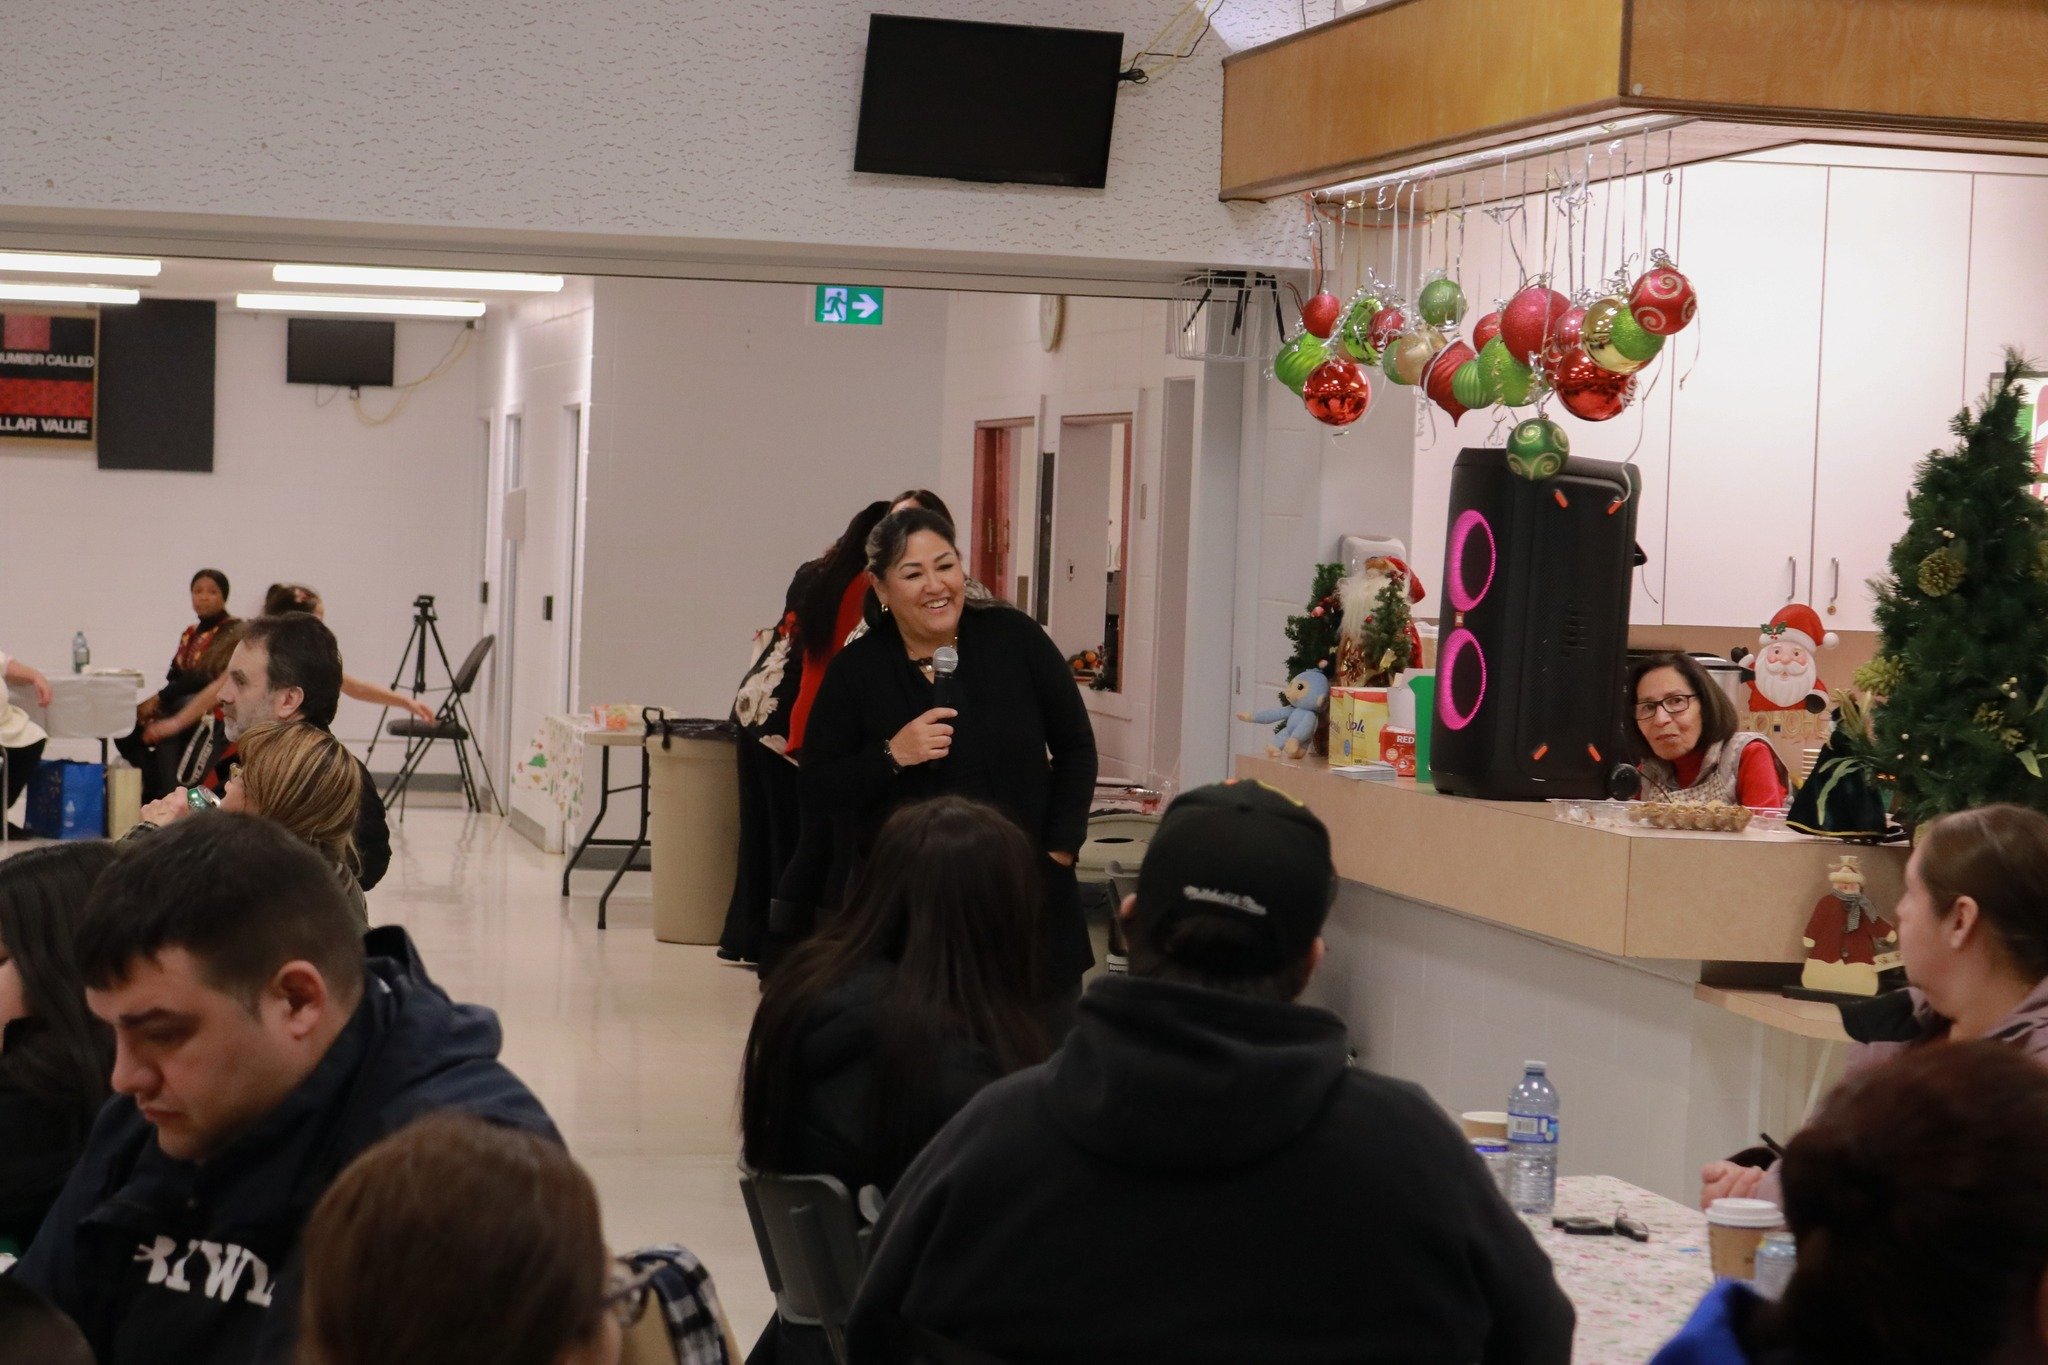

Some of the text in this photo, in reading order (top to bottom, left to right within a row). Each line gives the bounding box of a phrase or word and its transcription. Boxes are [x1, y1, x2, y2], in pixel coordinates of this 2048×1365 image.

[46, 353, 95, 368] CALLED
[41, 418, 88, 434] VALUE
[1396, 734, 1416, 745] RED
